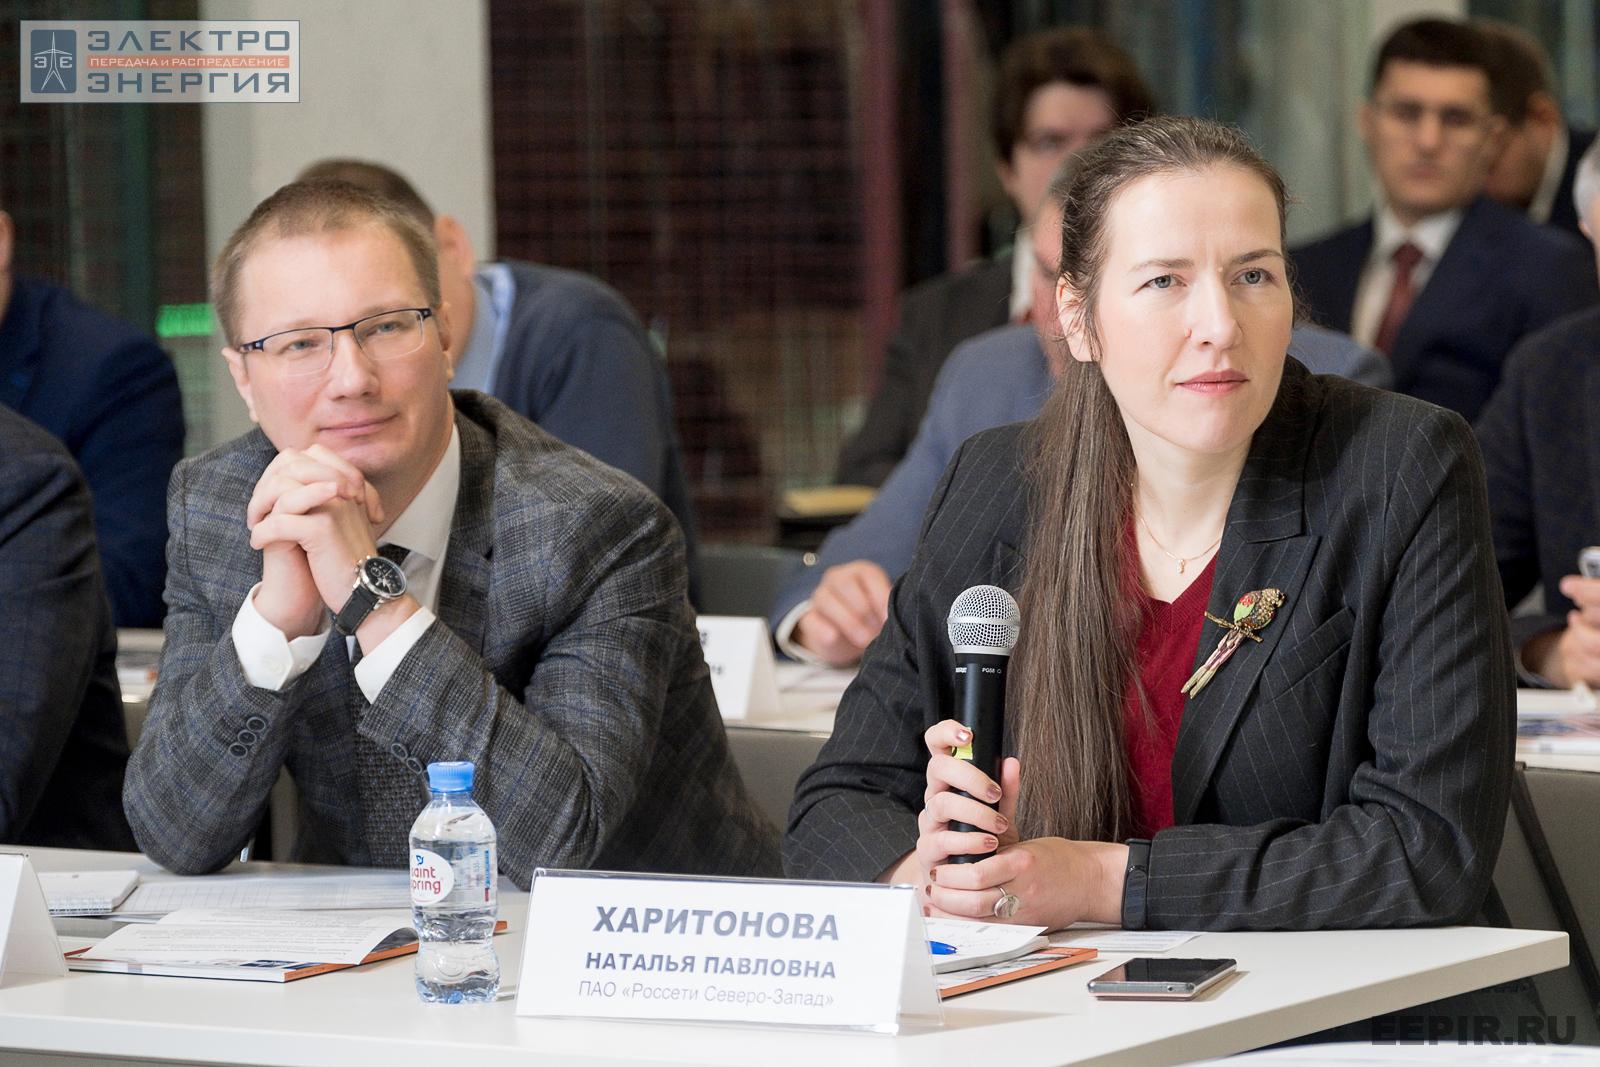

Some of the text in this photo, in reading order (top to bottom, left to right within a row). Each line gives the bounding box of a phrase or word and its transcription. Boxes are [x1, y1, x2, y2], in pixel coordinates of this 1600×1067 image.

[592, 905, 839, 941] ХАРИТОНОВА
[585, 951, 836, 979] НАТАЛЬЯ ПАВЛОВНА
[578, 980, 835, 1007] ПАО «Россети Северо-Запад»
